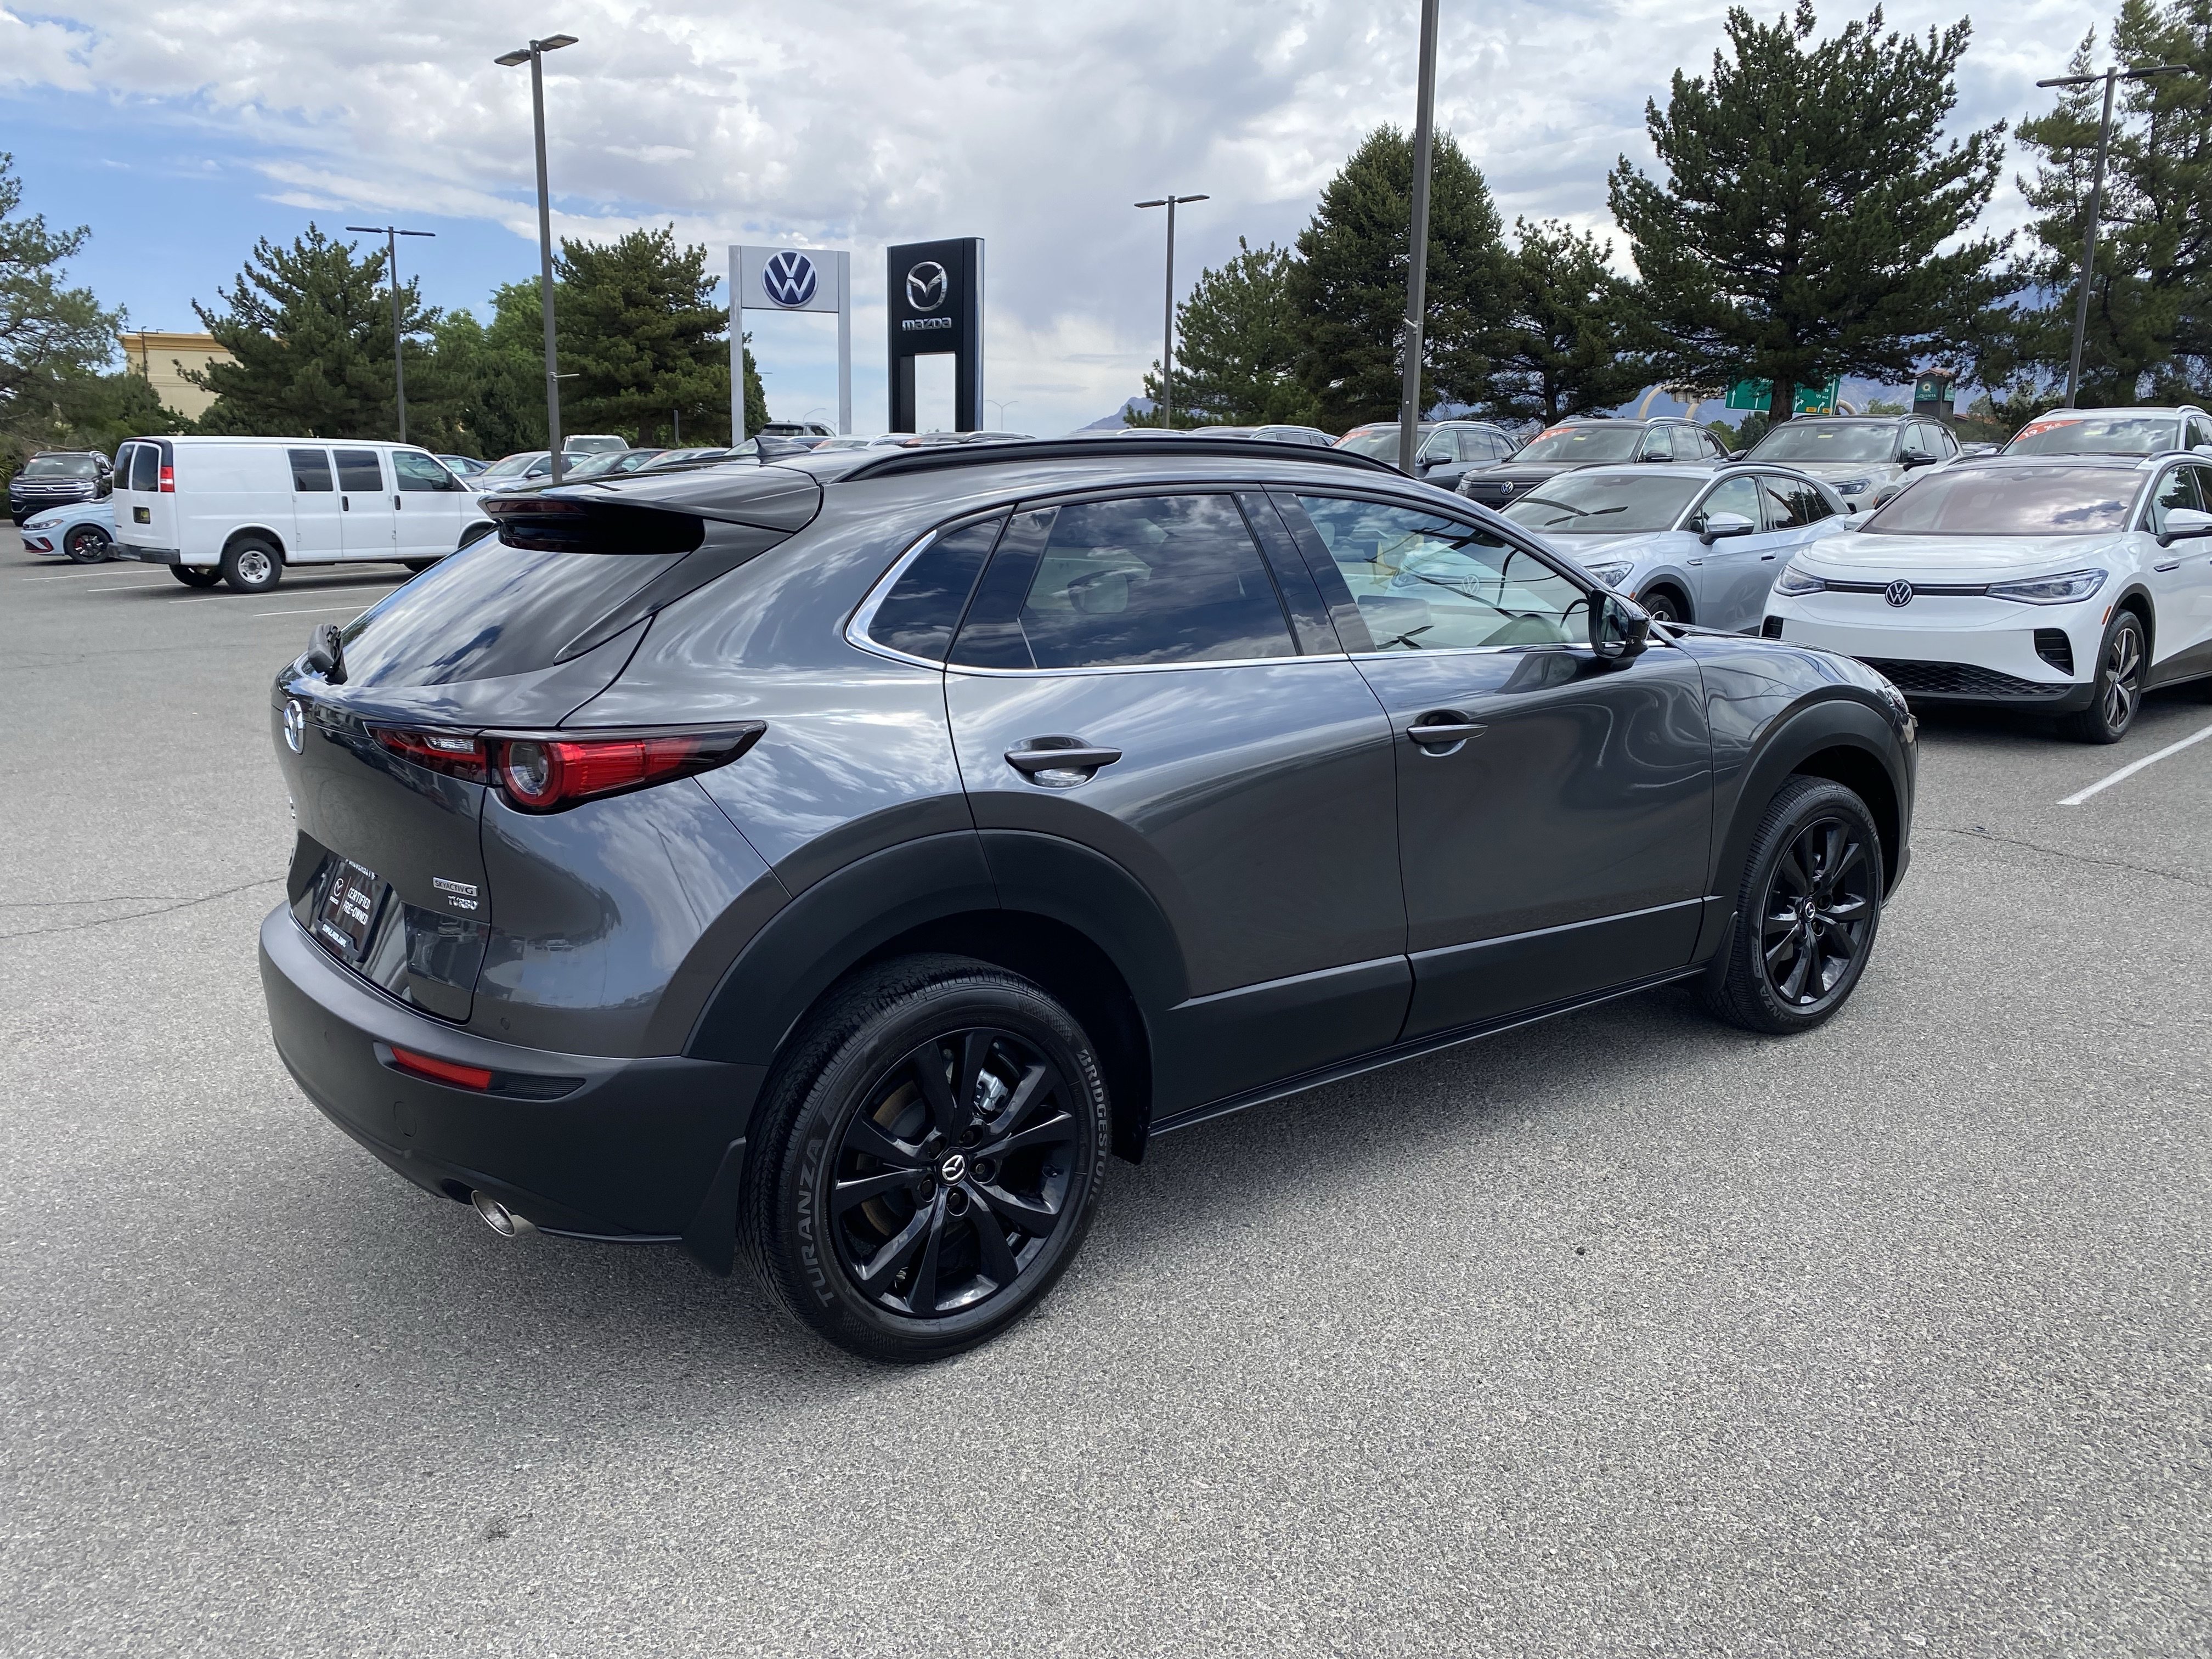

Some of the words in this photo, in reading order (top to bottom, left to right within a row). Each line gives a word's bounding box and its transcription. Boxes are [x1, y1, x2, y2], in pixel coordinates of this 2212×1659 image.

[347, 887, 371, 910] CERTIFIED
[448, 895, 478, 911] TURBO
[342, 900, 369, 926] PRE-OWNED
[797, 1138, 835, 1308] TURANZA
